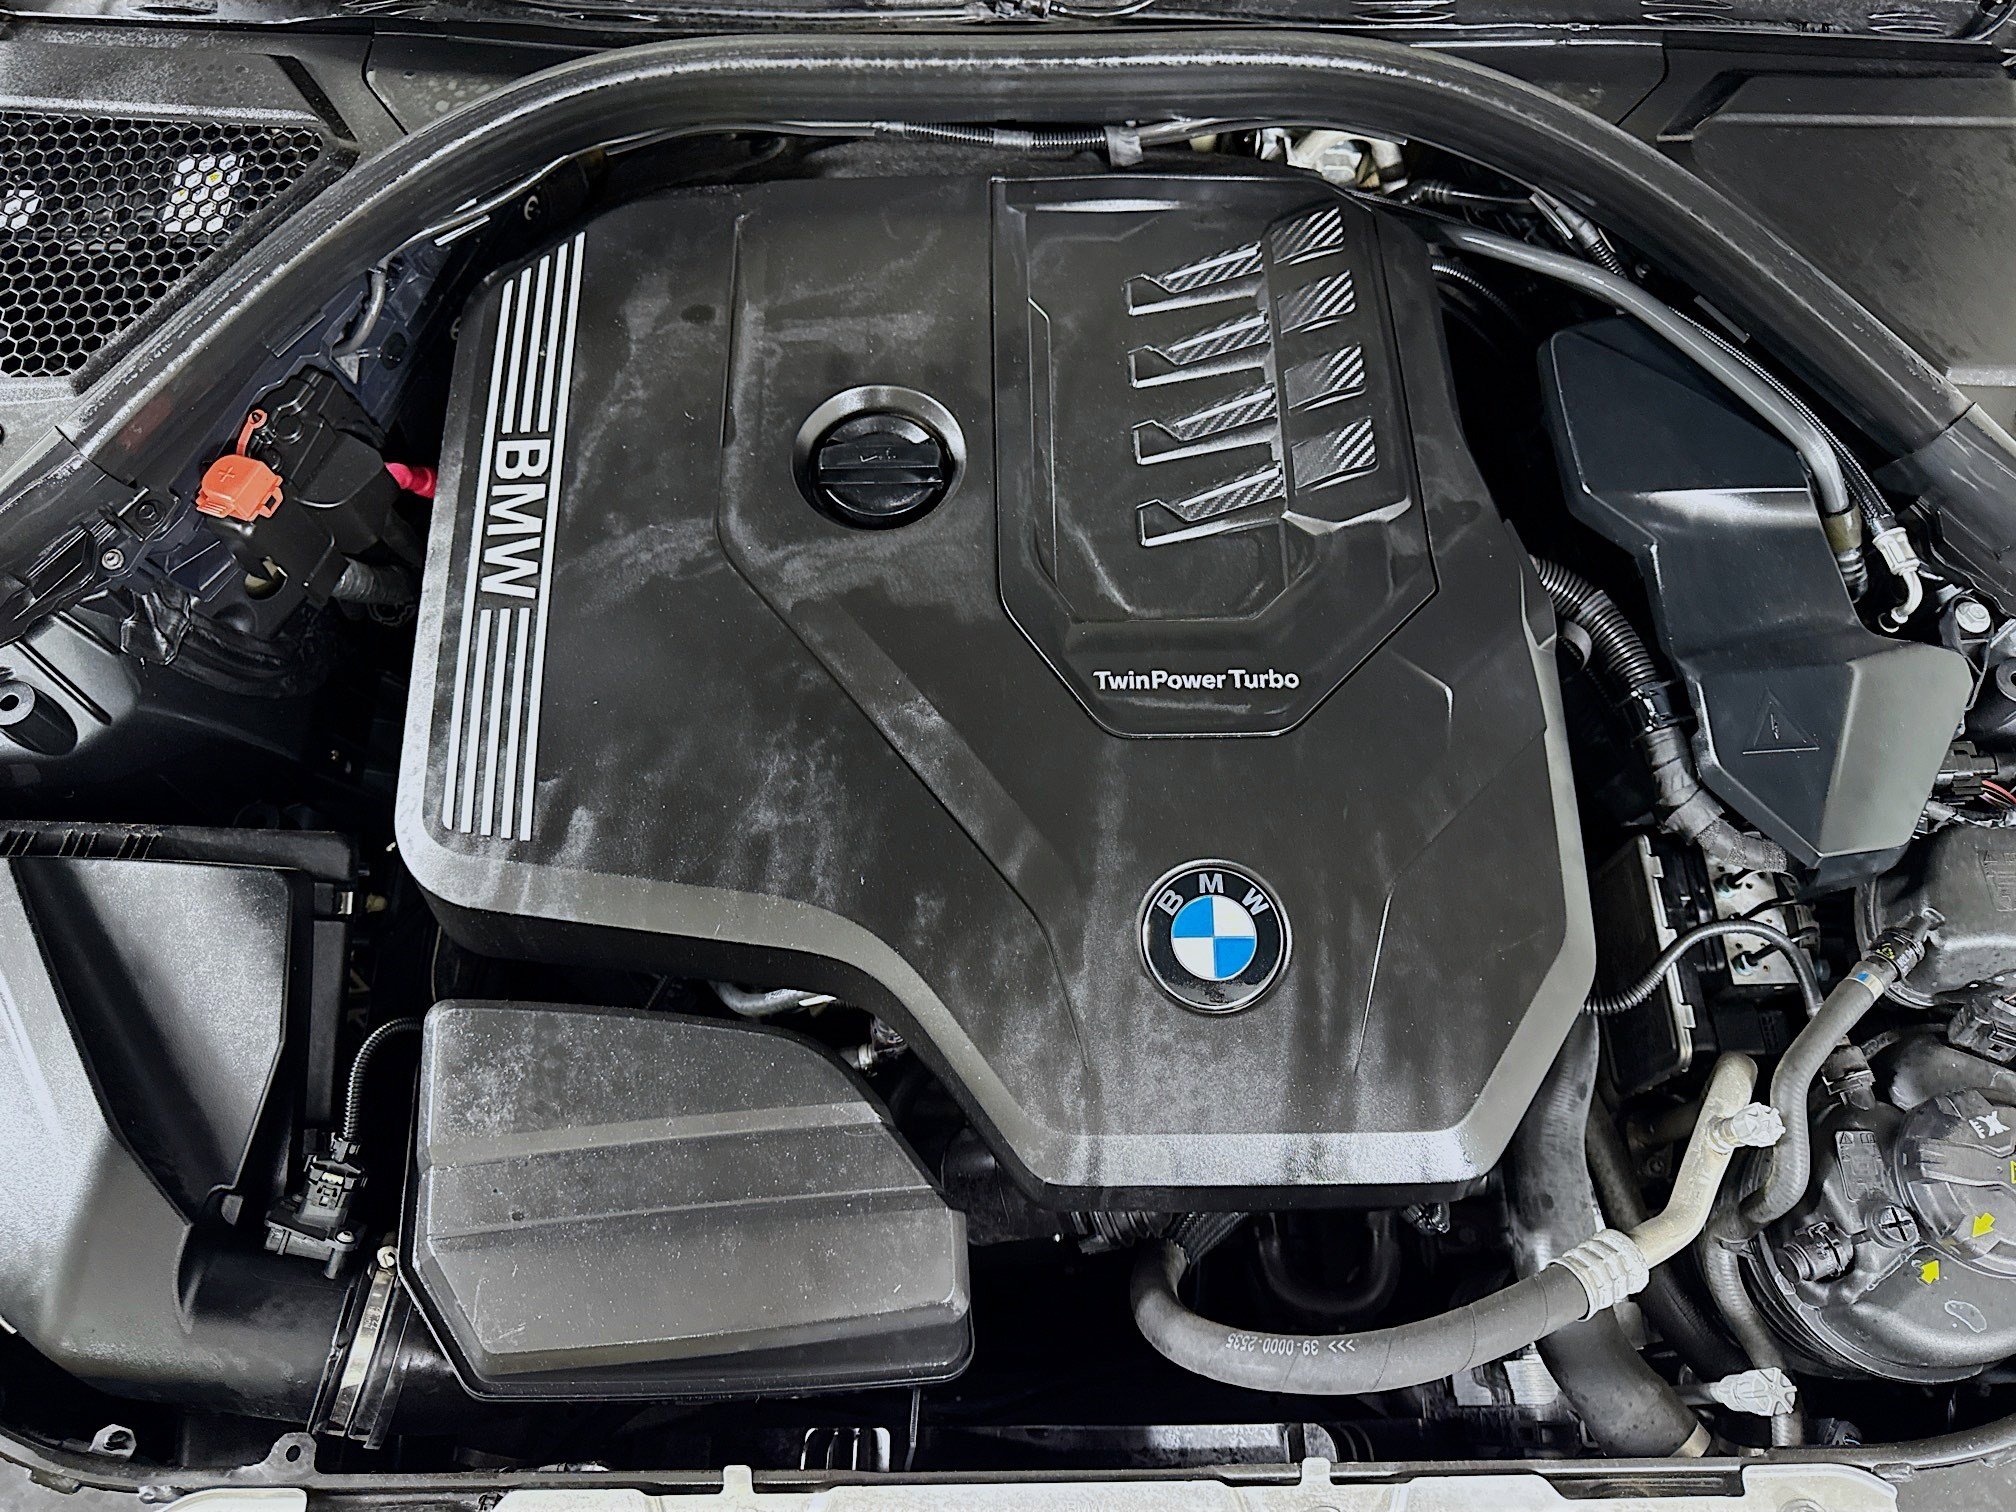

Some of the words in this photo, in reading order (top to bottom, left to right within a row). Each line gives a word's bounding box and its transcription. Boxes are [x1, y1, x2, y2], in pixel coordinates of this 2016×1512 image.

[481, 439, 551, 599] BMW
[1093, 670, 1226, 690] TwinPower
[1228, 668, 1300, 689] Turbo
[1156, 873, 1270, 916] BMW
